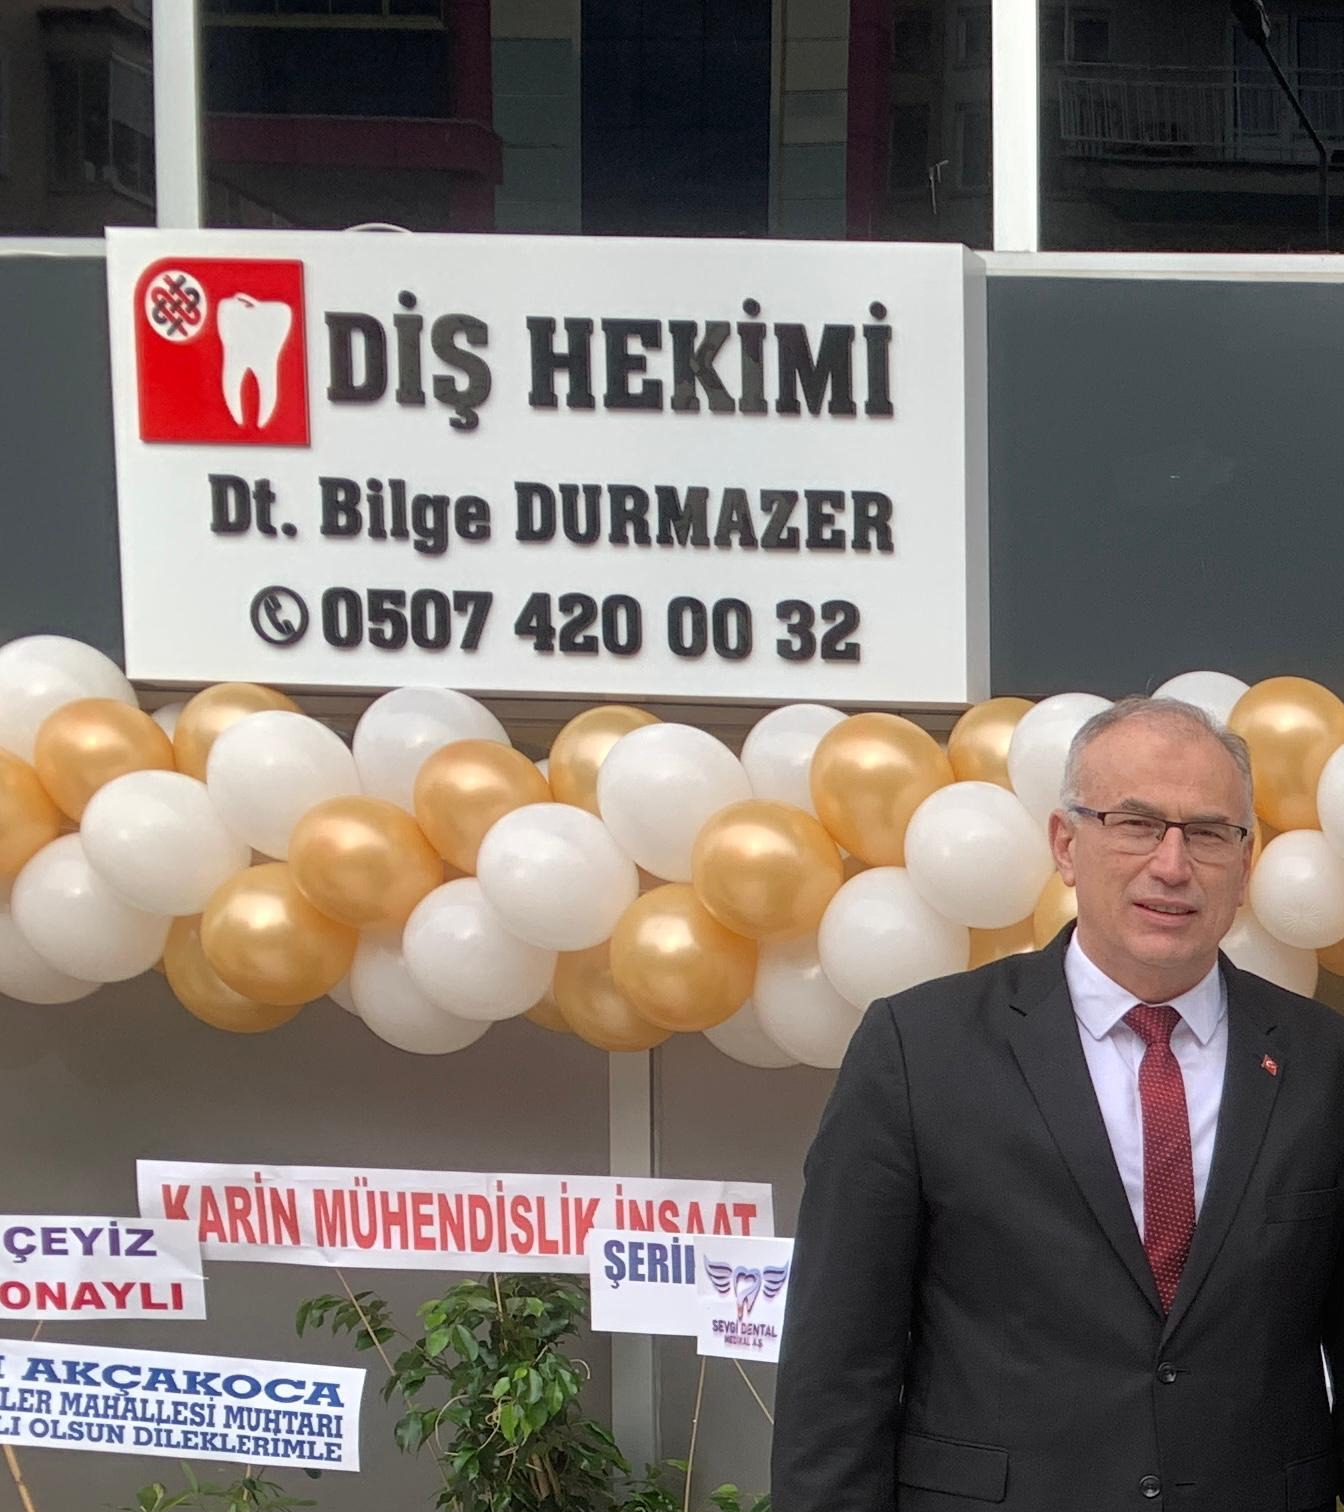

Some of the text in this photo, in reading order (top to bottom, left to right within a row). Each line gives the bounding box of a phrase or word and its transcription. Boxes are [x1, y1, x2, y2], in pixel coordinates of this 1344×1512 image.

[324, 289, 894, 431] DİŞ HEKİMİ
[208, 473, 896, 554] Dt. Bilge DURMAZER
[321, 586, 861, 662] 0507 420 00 32
[161, 1172, 301, 1246] KARİN
[313, 1176, 600, 1256] MÜHENDİSLİK
[3, 1221, 157, 1263] ÇEYİZ
[0, 1281, 184, 1311] ONAYLI
[741, 1322, 777, 1338] DENTAL
[22, 1357, 345, 1408] AKÇAKOCA
[59, 1391, 216, 1428] MAHALLESİ
[223, 1405, 344, 1439] MUHTARI
[29, 1417, 125, 1445] OLSUN
[133, 1420, 343, 1463] DİLEKLERİMLE
